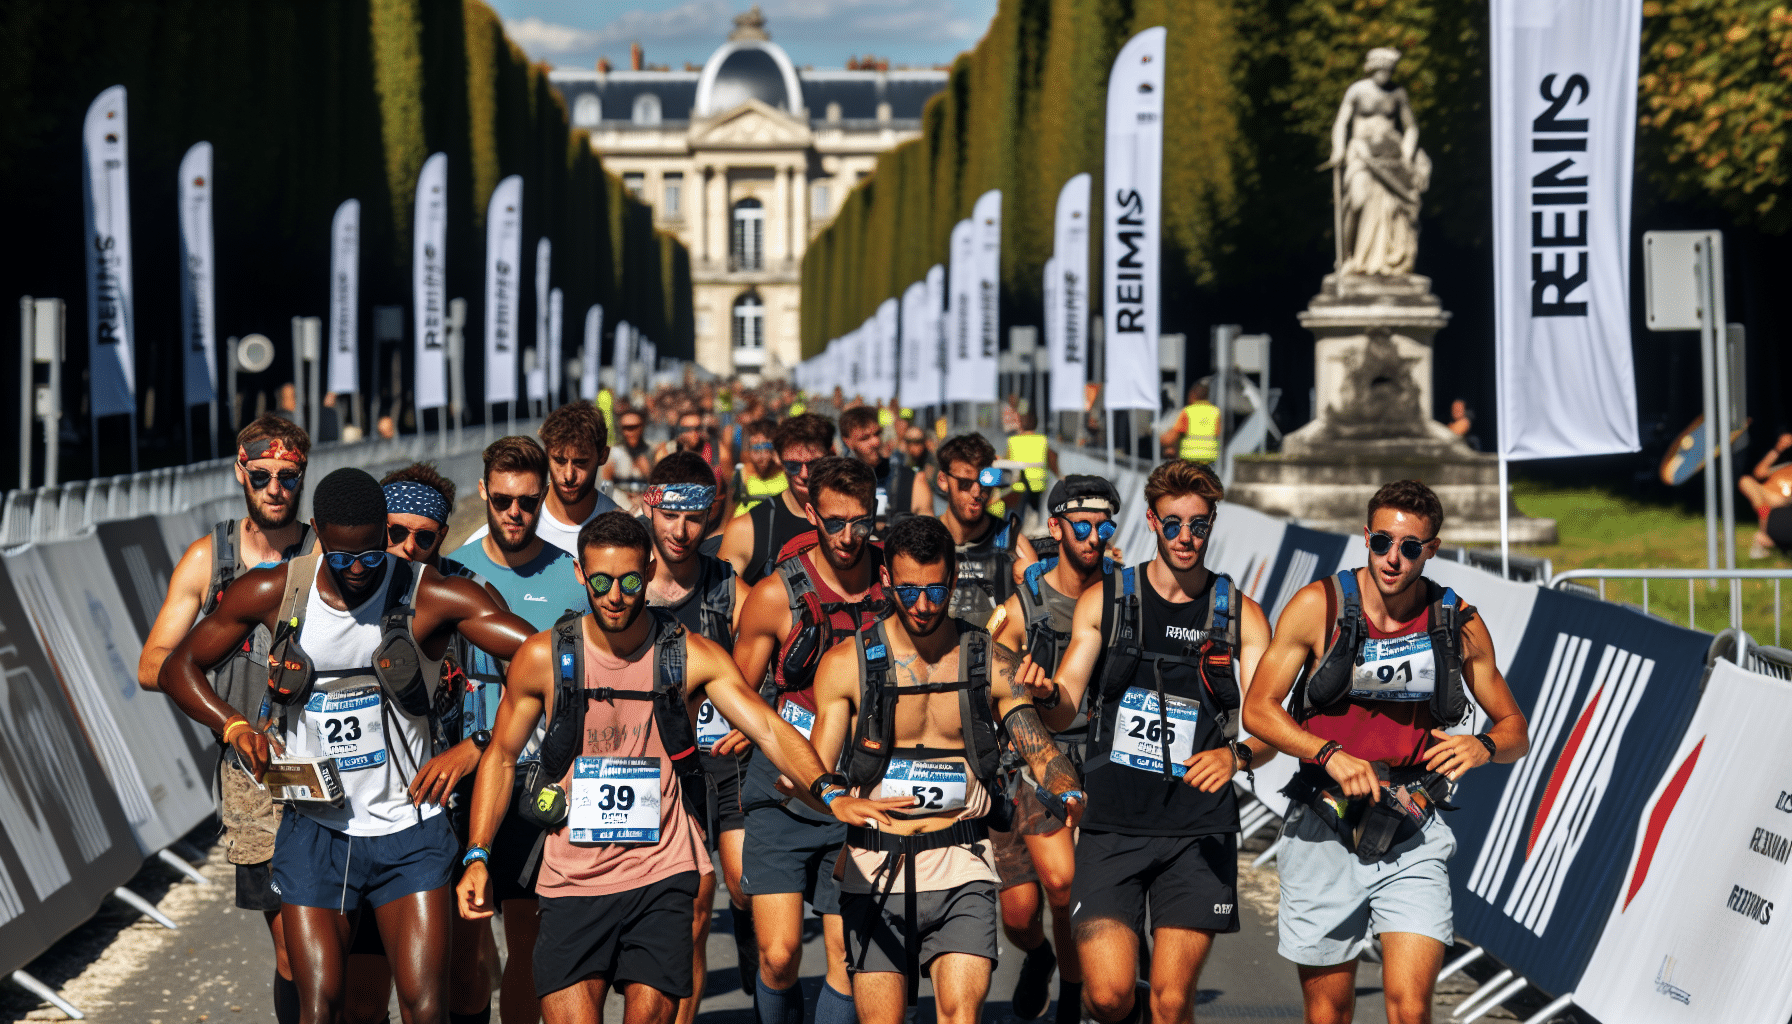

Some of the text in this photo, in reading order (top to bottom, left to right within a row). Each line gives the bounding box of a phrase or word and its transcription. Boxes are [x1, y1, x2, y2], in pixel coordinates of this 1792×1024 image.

[325, 716, 361, 743] 23
[598, 784, 635, 810] 39
[912, 786, 944, 809] 52
